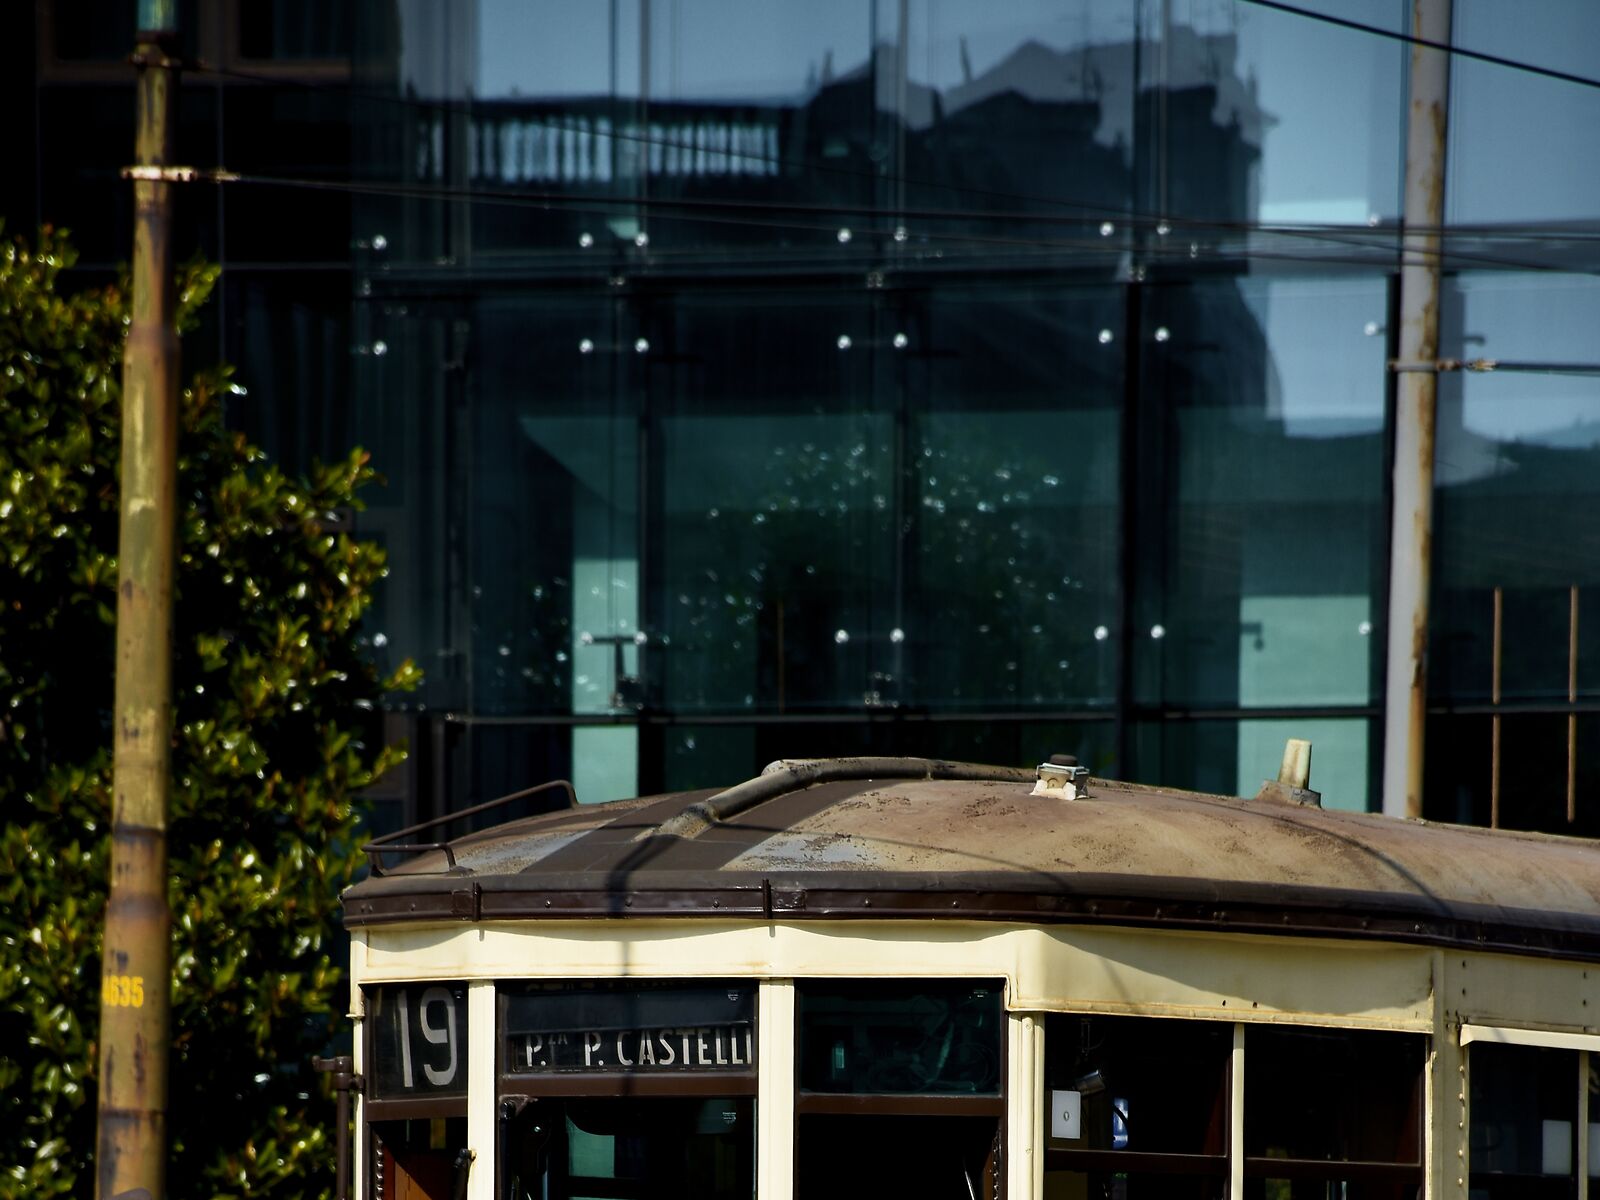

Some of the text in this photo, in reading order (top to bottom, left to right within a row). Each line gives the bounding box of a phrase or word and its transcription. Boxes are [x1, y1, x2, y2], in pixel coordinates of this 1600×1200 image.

[397, 986, 458, 1088] 19
[584, 1031, 604, 1067] P.
[616, 1027, 752, 1066] CASTELLI
